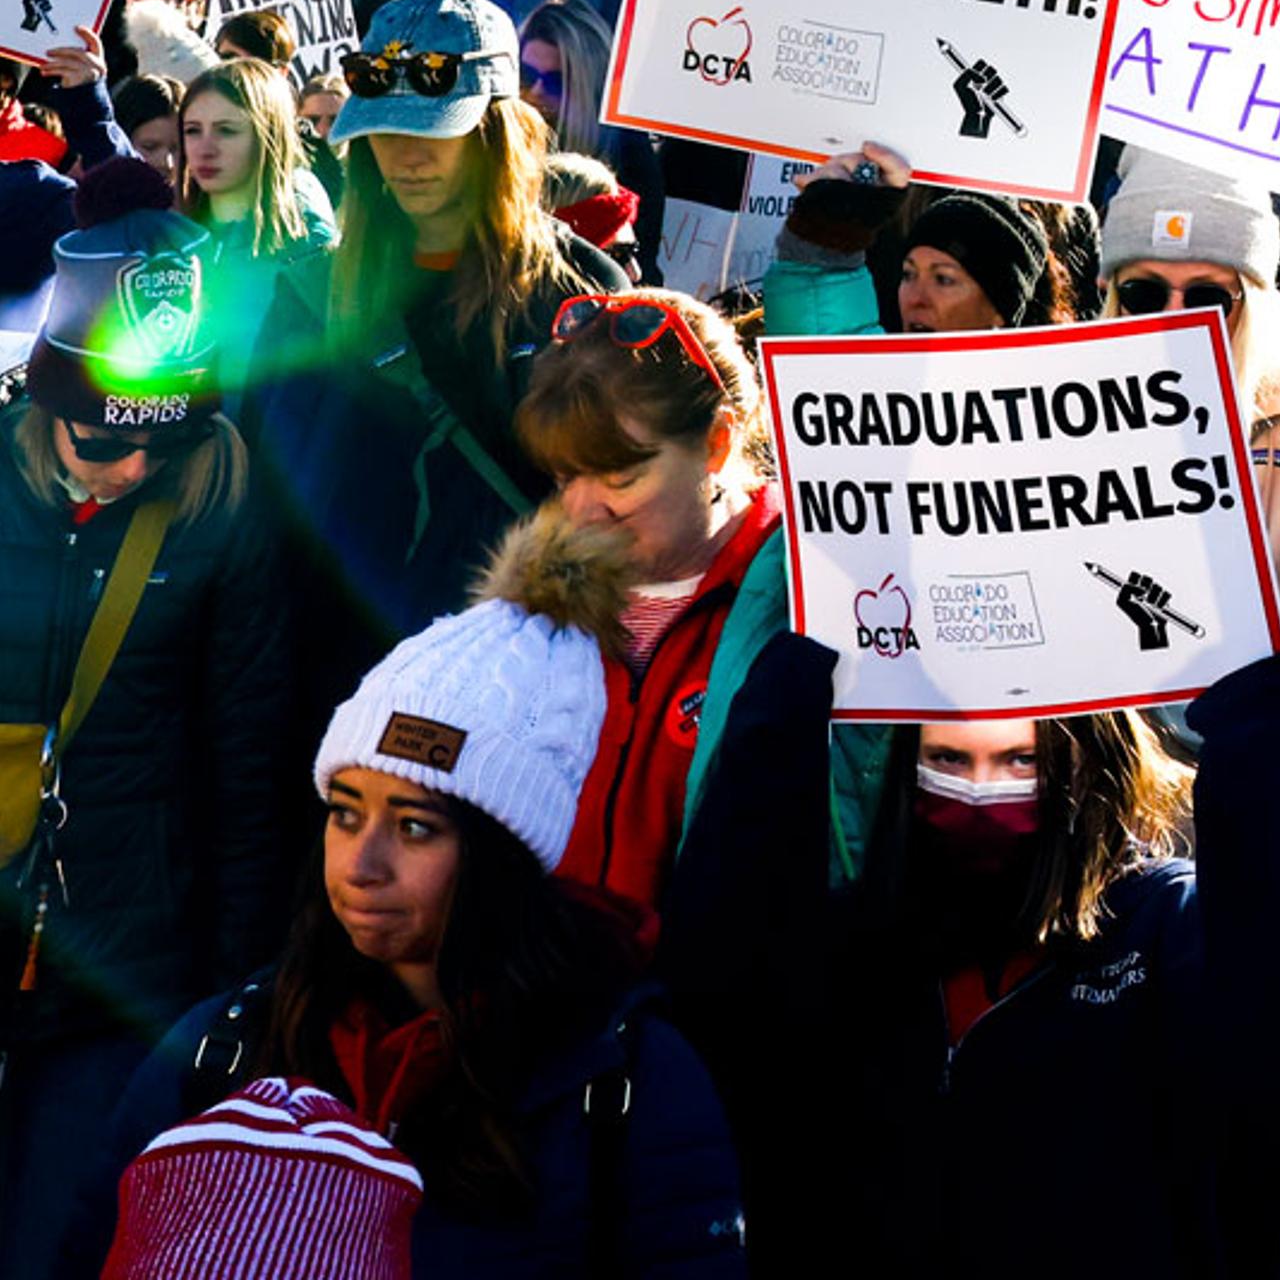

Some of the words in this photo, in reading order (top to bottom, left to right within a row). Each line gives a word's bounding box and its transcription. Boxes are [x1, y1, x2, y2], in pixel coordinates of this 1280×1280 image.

[777, 25, 859, 55] COLORADO
[682, 49, 752, 82] DCTA
[775, 44, 860, 75] EDUCATION
[771, 64, 871, 98] ASSOCIATION
[105, 403, 188, 425] RAPIDS
[106, 392, 190, 409] COLORADO
[792, 370, 1211, 447] GRADUATIONS,
[798, 481, 894, 535] NOT
[908, 455, 1236, 536] FUNERALS!
[929, 584, 1008, 603] COLORADO
[933, 604, 1018, 624] EDUCATION
[857, 626, 920, 651] DCTA
[936, 622, 1035, 643] ASSOCIATION
